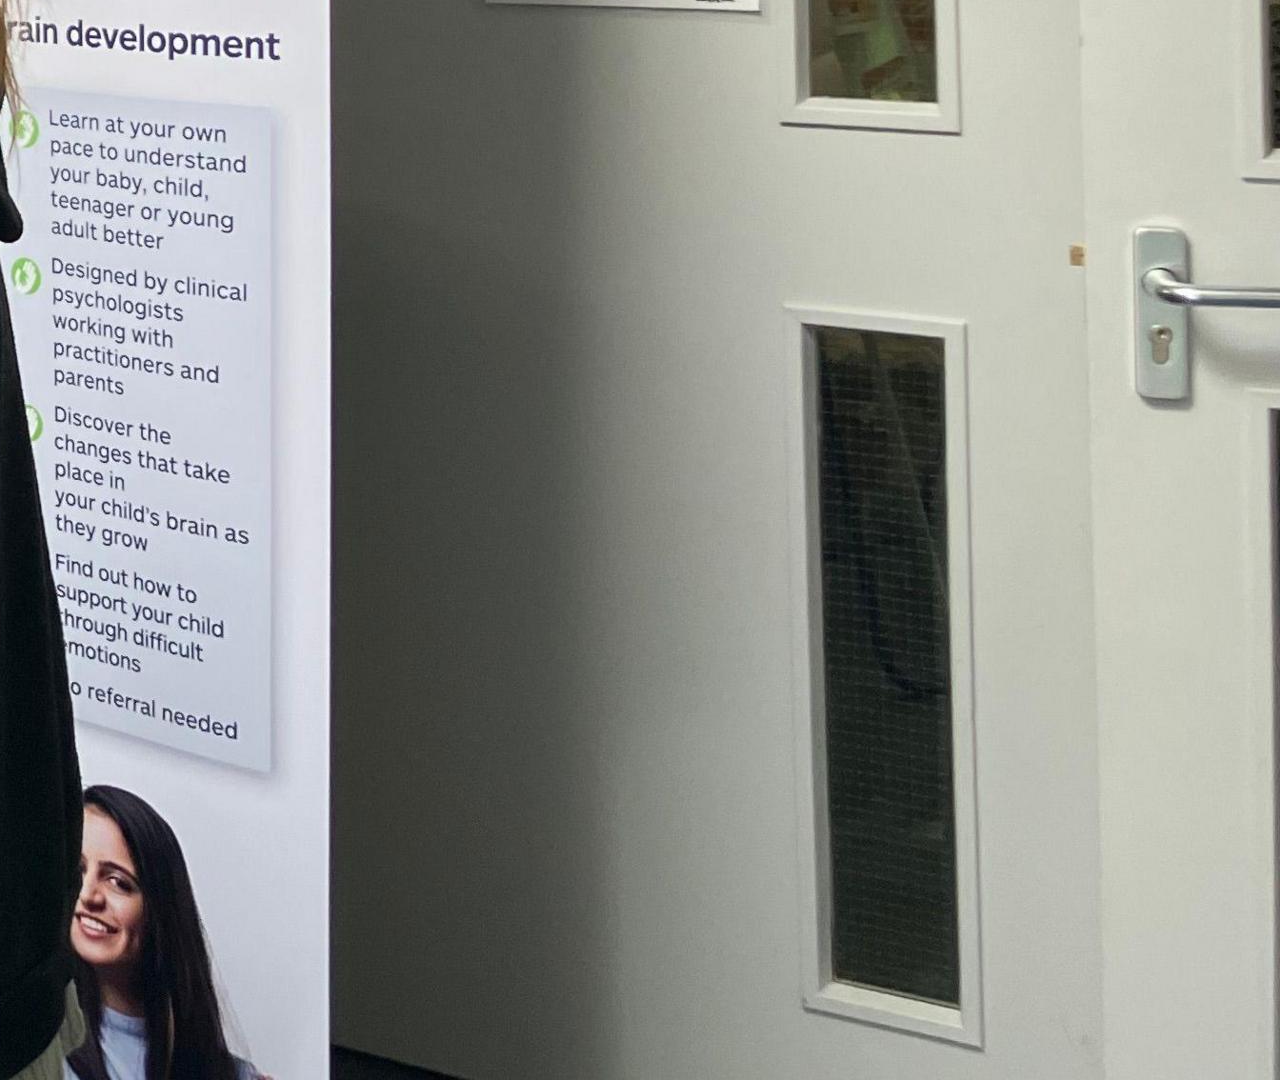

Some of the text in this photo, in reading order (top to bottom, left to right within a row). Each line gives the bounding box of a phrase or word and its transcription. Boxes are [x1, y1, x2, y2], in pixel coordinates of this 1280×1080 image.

[7, 16, 281, 61] rain development
[49, 109, 227, 144] Learn at your own
[50, 138, 247, 174] pace to understand
[50, 165, 209, 201] your baby, child,
[51, 191, 235, 234] teenager or young
[51, 219, 164, 251] adult better
[51, 257, 248, 303] Designed by clinical
[52, 286, 185, 323] psychologists
[53, 315, 174, 349] working with
[53, 340, 220, 384] practitioners and
[54, 368, 125, 396] parents
[54, 406, 172, 446] Discover the
[54, 433, 231, 485] changes that take
[55, 461, 125, 491] place in
[55, 488, 250, 546] your child's brain as
[55, 513, 149, 553] they grow
[55, 553, 197, 605] Find out how to
[56, 581, 225, 640] support your child
[65, 640, 141, 674] motions
[133, 625, 204, 663] difficult
[70, 681, 238, 740] o referral needed
